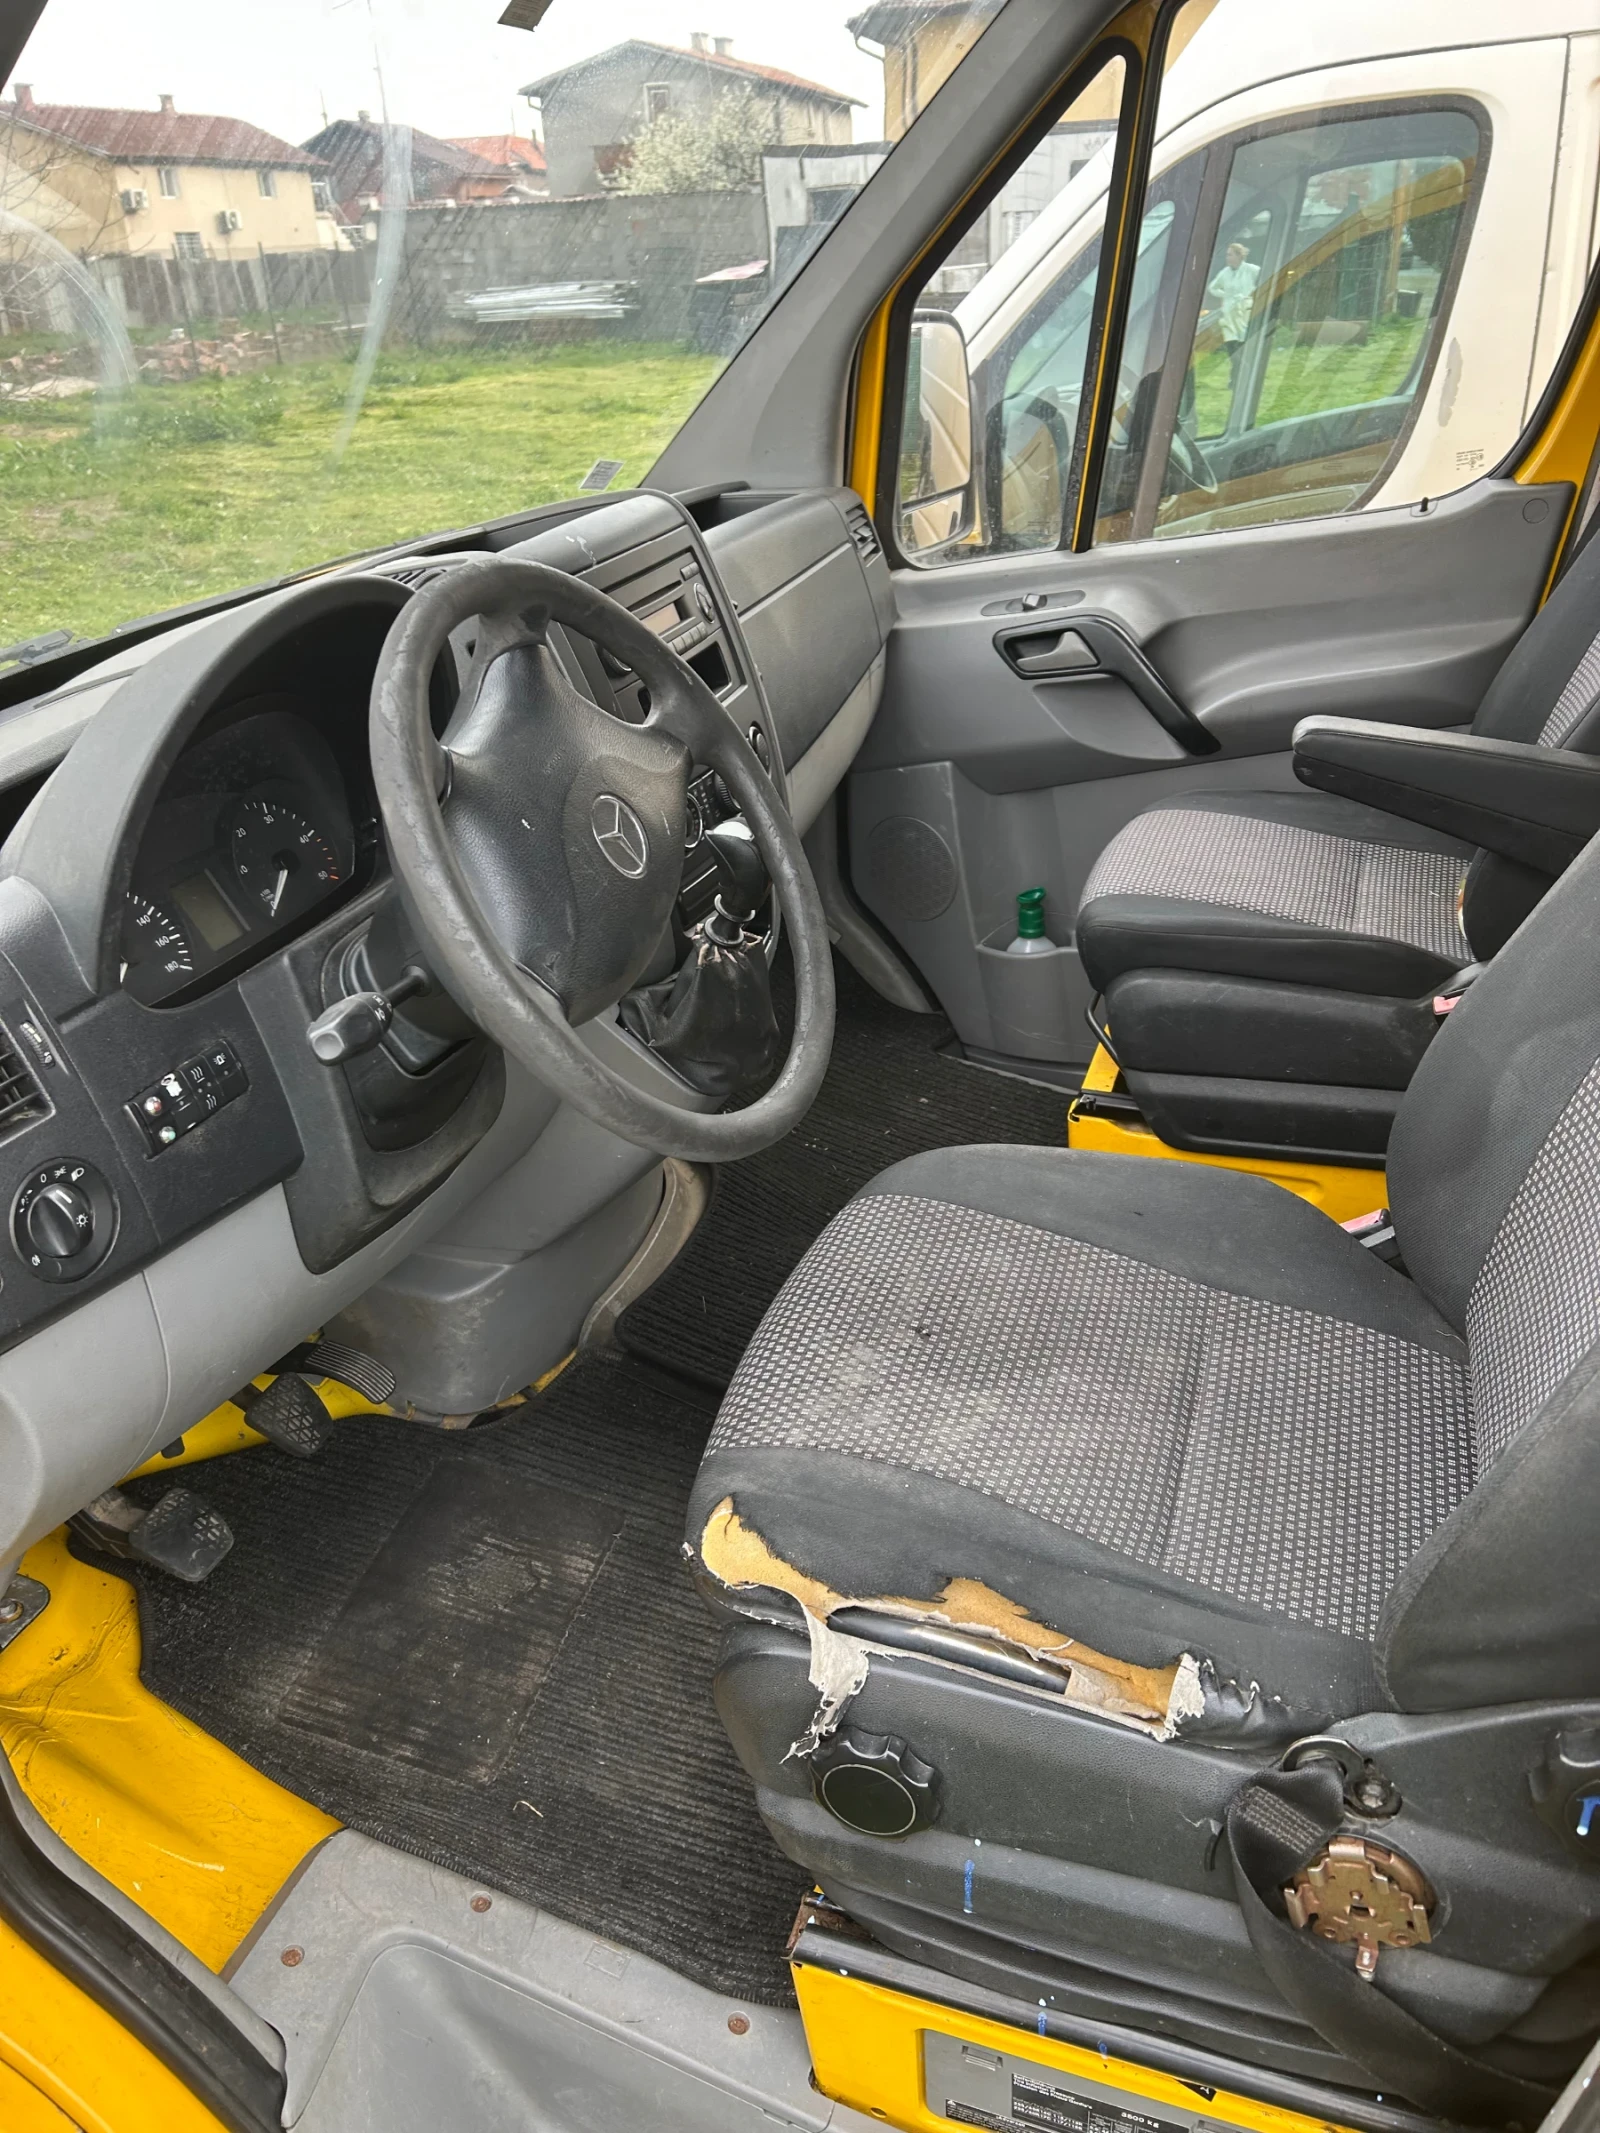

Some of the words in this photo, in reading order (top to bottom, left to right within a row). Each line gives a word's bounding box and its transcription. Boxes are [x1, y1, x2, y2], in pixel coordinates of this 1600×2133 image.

[263, 814, 274, 824] 30
[236, 827, 247, 838] 20
[300, 834, 310, 844] 40
[239, 864, 249, 875] 10
[318, 870, 328, 880] 50
[136, 914, 151, 927] 140
[155, 935, 170, 948] 160
[164, 960, 179, 973] 180
[40, 1173, 47, 1183] 0
[1121, 2111, 1145, 2123] 3500
[1147, 2119, 1160, 2129] kg
